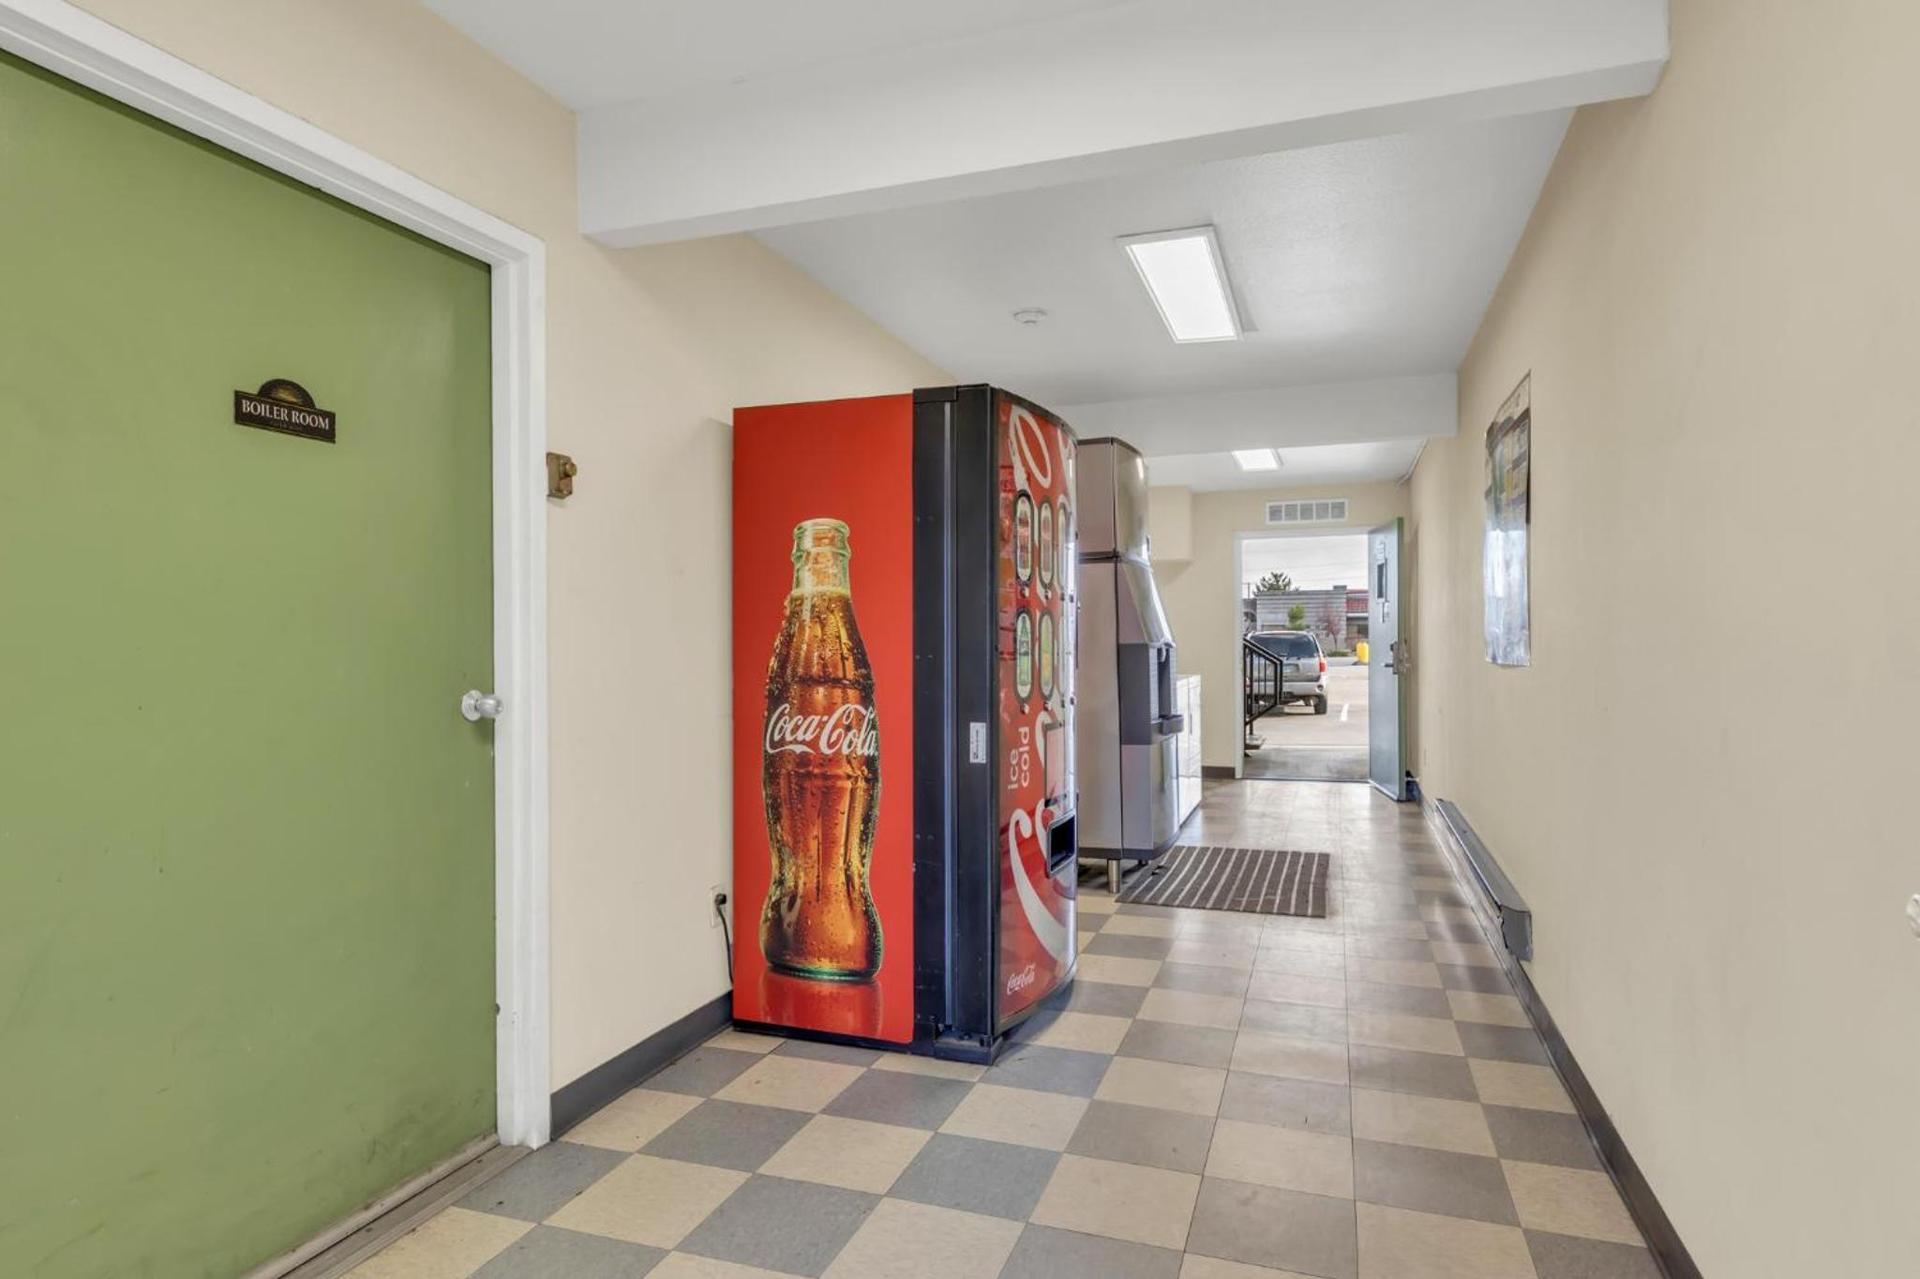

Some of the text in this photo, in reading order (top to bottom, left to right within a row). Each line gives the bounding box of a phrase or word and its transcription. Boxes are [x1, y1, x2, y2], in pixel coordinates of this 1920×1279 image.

[242, 400, 289, 421] BOILER
[291, 410, 330, 430] ROOM
[766, 703, 877, 756] Coca-Cola
[1019, 726, 1030, 788] cold
